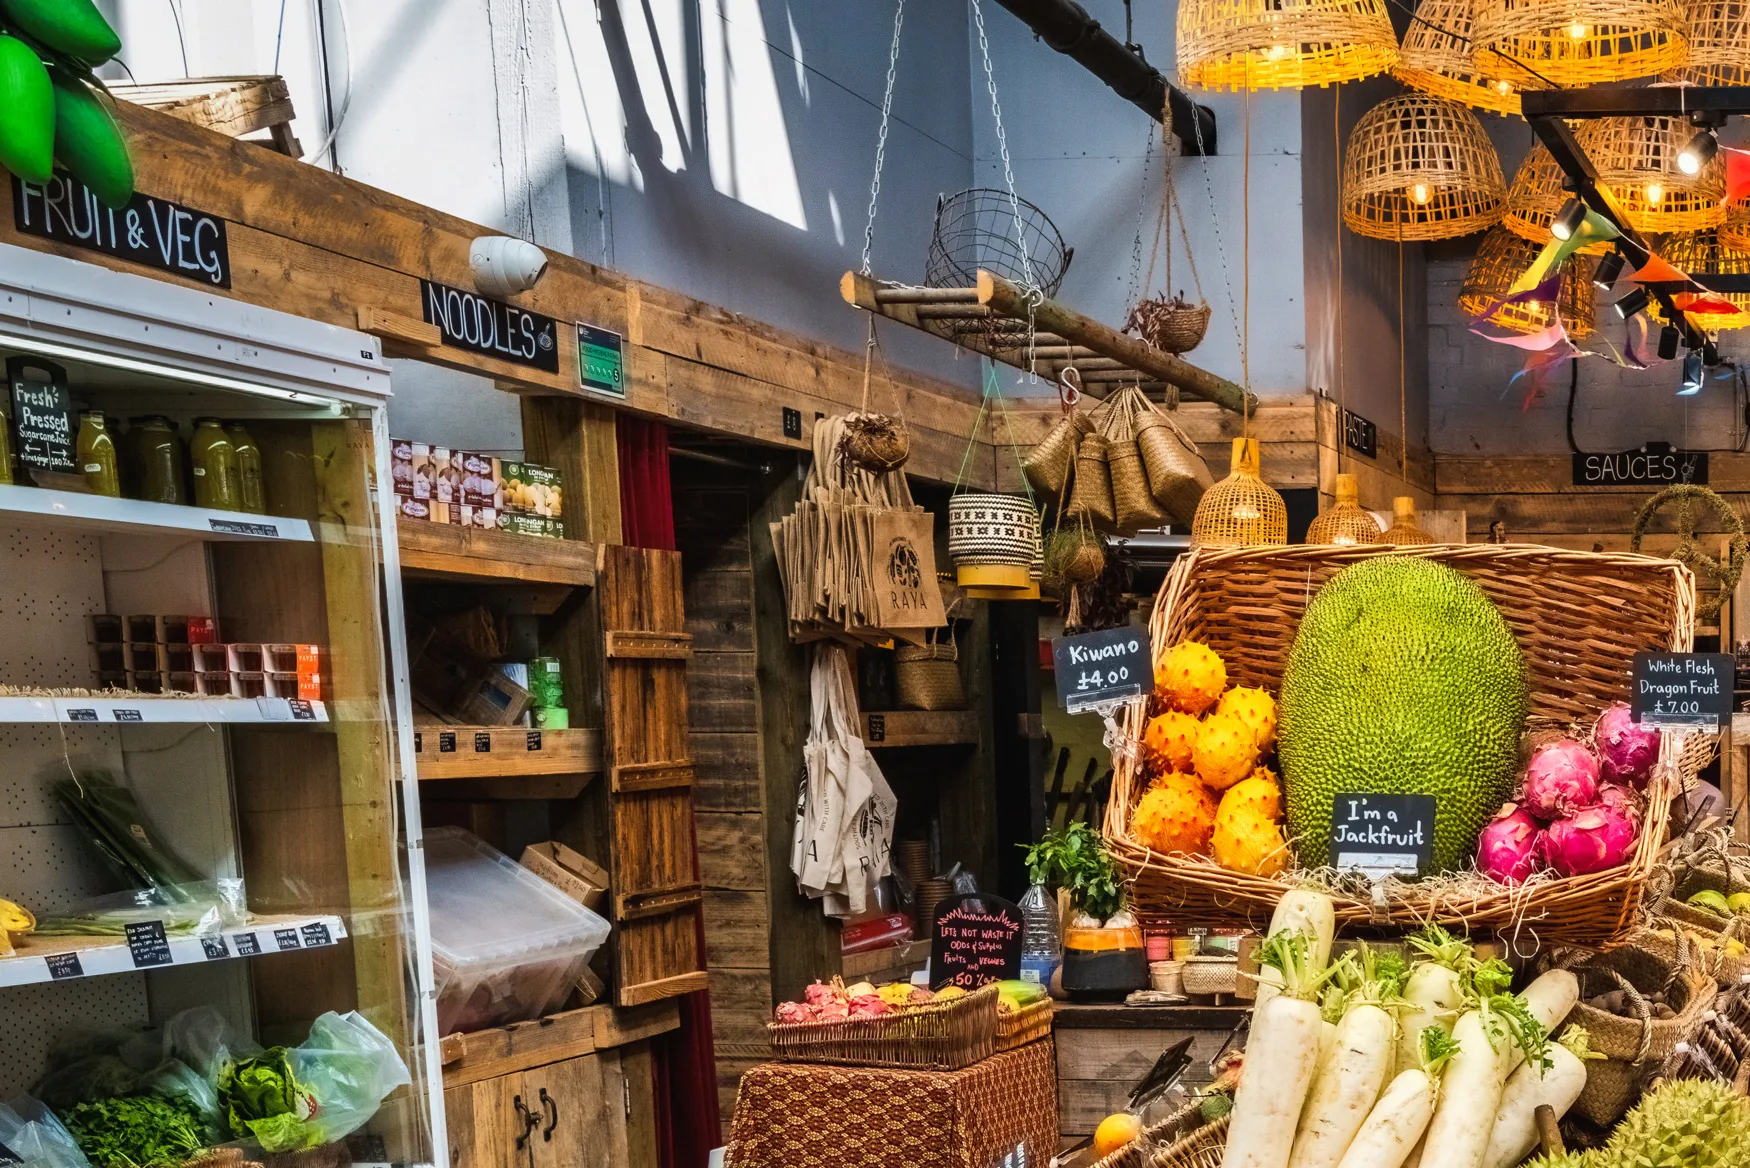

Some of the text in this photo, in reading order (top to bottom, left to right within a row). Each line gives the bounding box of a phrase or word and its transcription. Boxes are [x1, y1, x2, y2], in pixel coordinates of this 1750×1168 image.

[126, 209, 149, 249] &
[147, 200, 222, 284] VEG
[429, 283, 536, 359] NOODLES
[15, 383, 54, 408] Fresh
[23, 407, 69, 432] Pressed
[1585, 455, 1676, 483] SAUCES
[891, 591, 927, 609] RAYA
[1069, 640, 1139, 665] Kiwano
[1077, 666, 1129, 690] £4.00
[1648, 658, 1715, 675] White Flesh
[1640, 678, 1720, 698] Dragon Fruit
[1347, 798, 1398, 822] I'm a
[1333, 820, 1424, 846] Jackfruit
[962, 928, 977, 937] NOT
[982, 930, 1004, 940] WASTE
[1006, 931, 1014, 940] IT
[956, 972, 973, 985] 50
